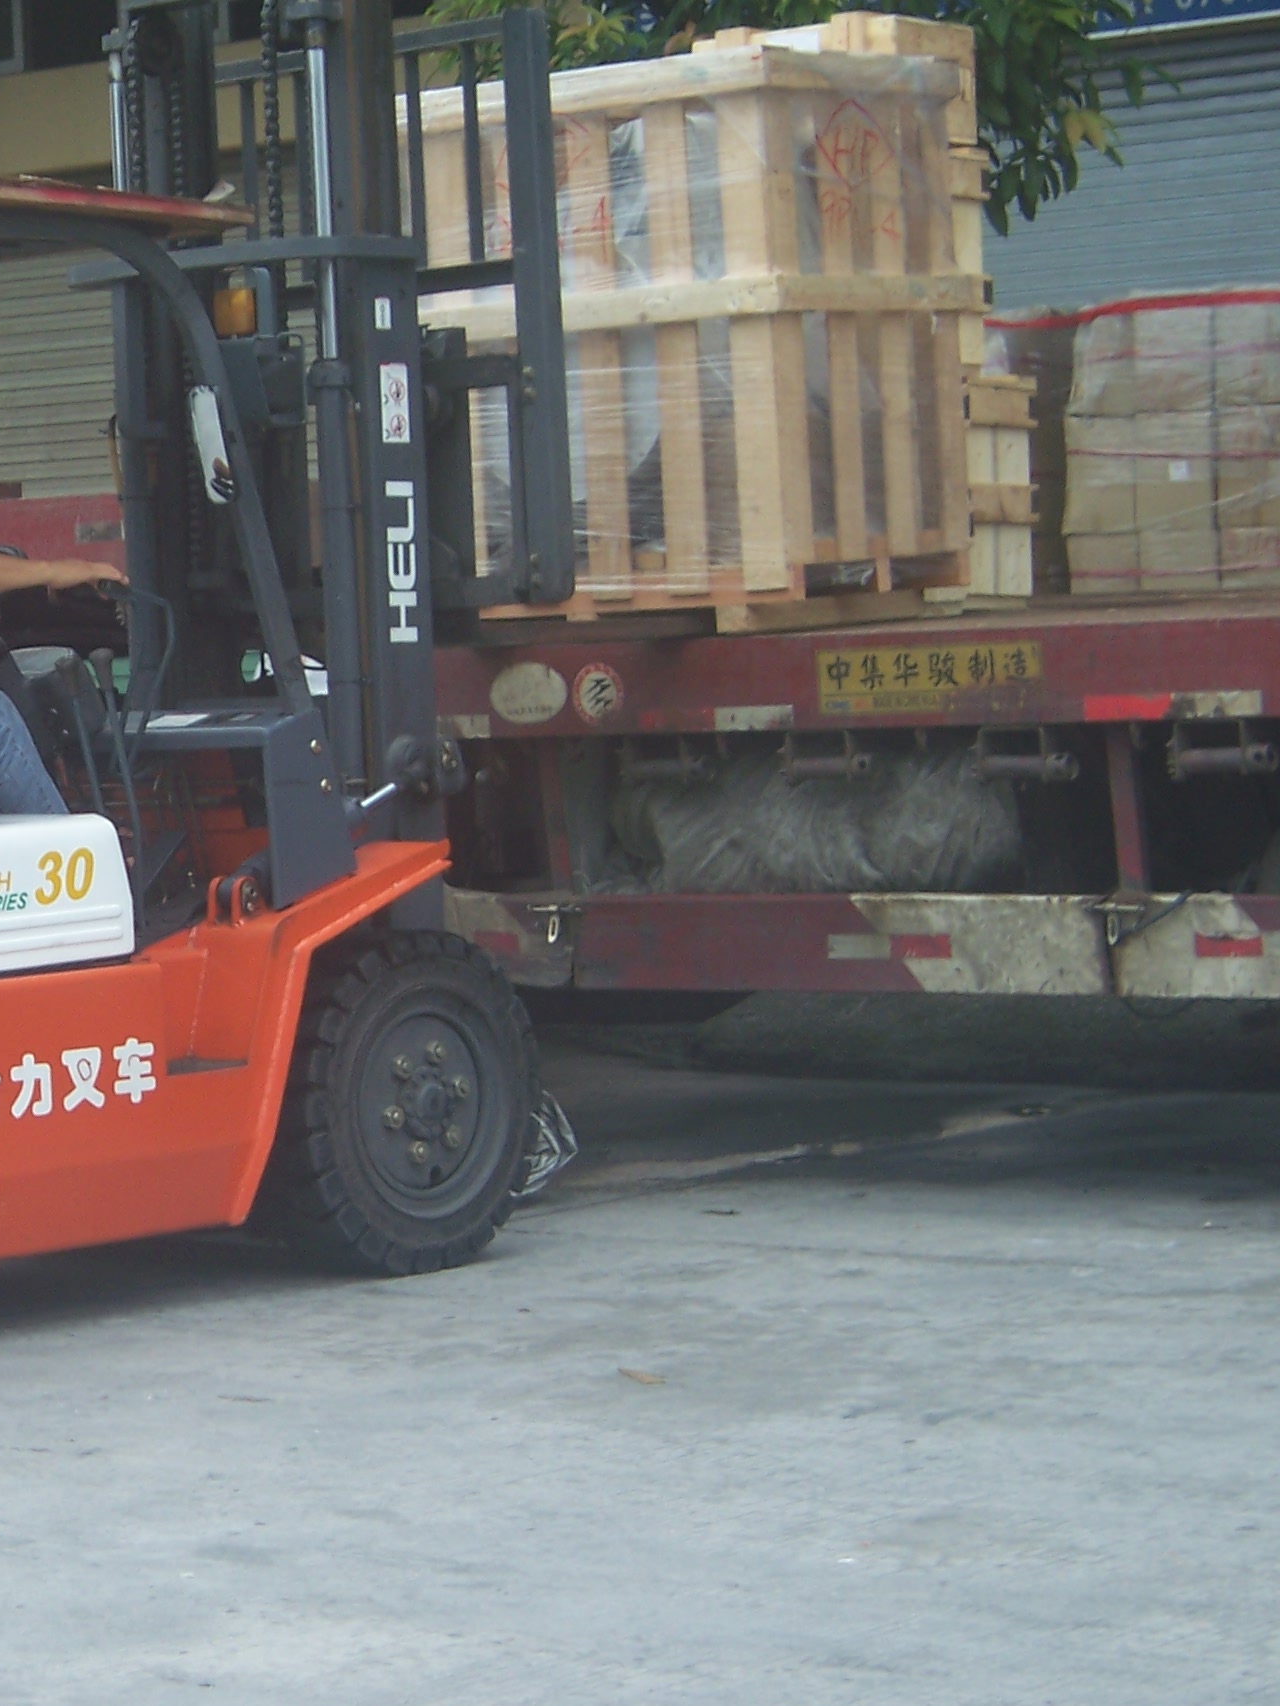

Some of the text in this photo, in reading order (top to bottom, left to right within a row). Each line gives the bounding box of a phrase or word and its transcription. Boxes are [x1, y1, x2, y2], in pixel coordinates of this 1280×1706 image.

[385, 480, 419, 643] HELI
[826, 647, 1032, 690] 中集华骏制造
[35, 847, 95, 905] 30
